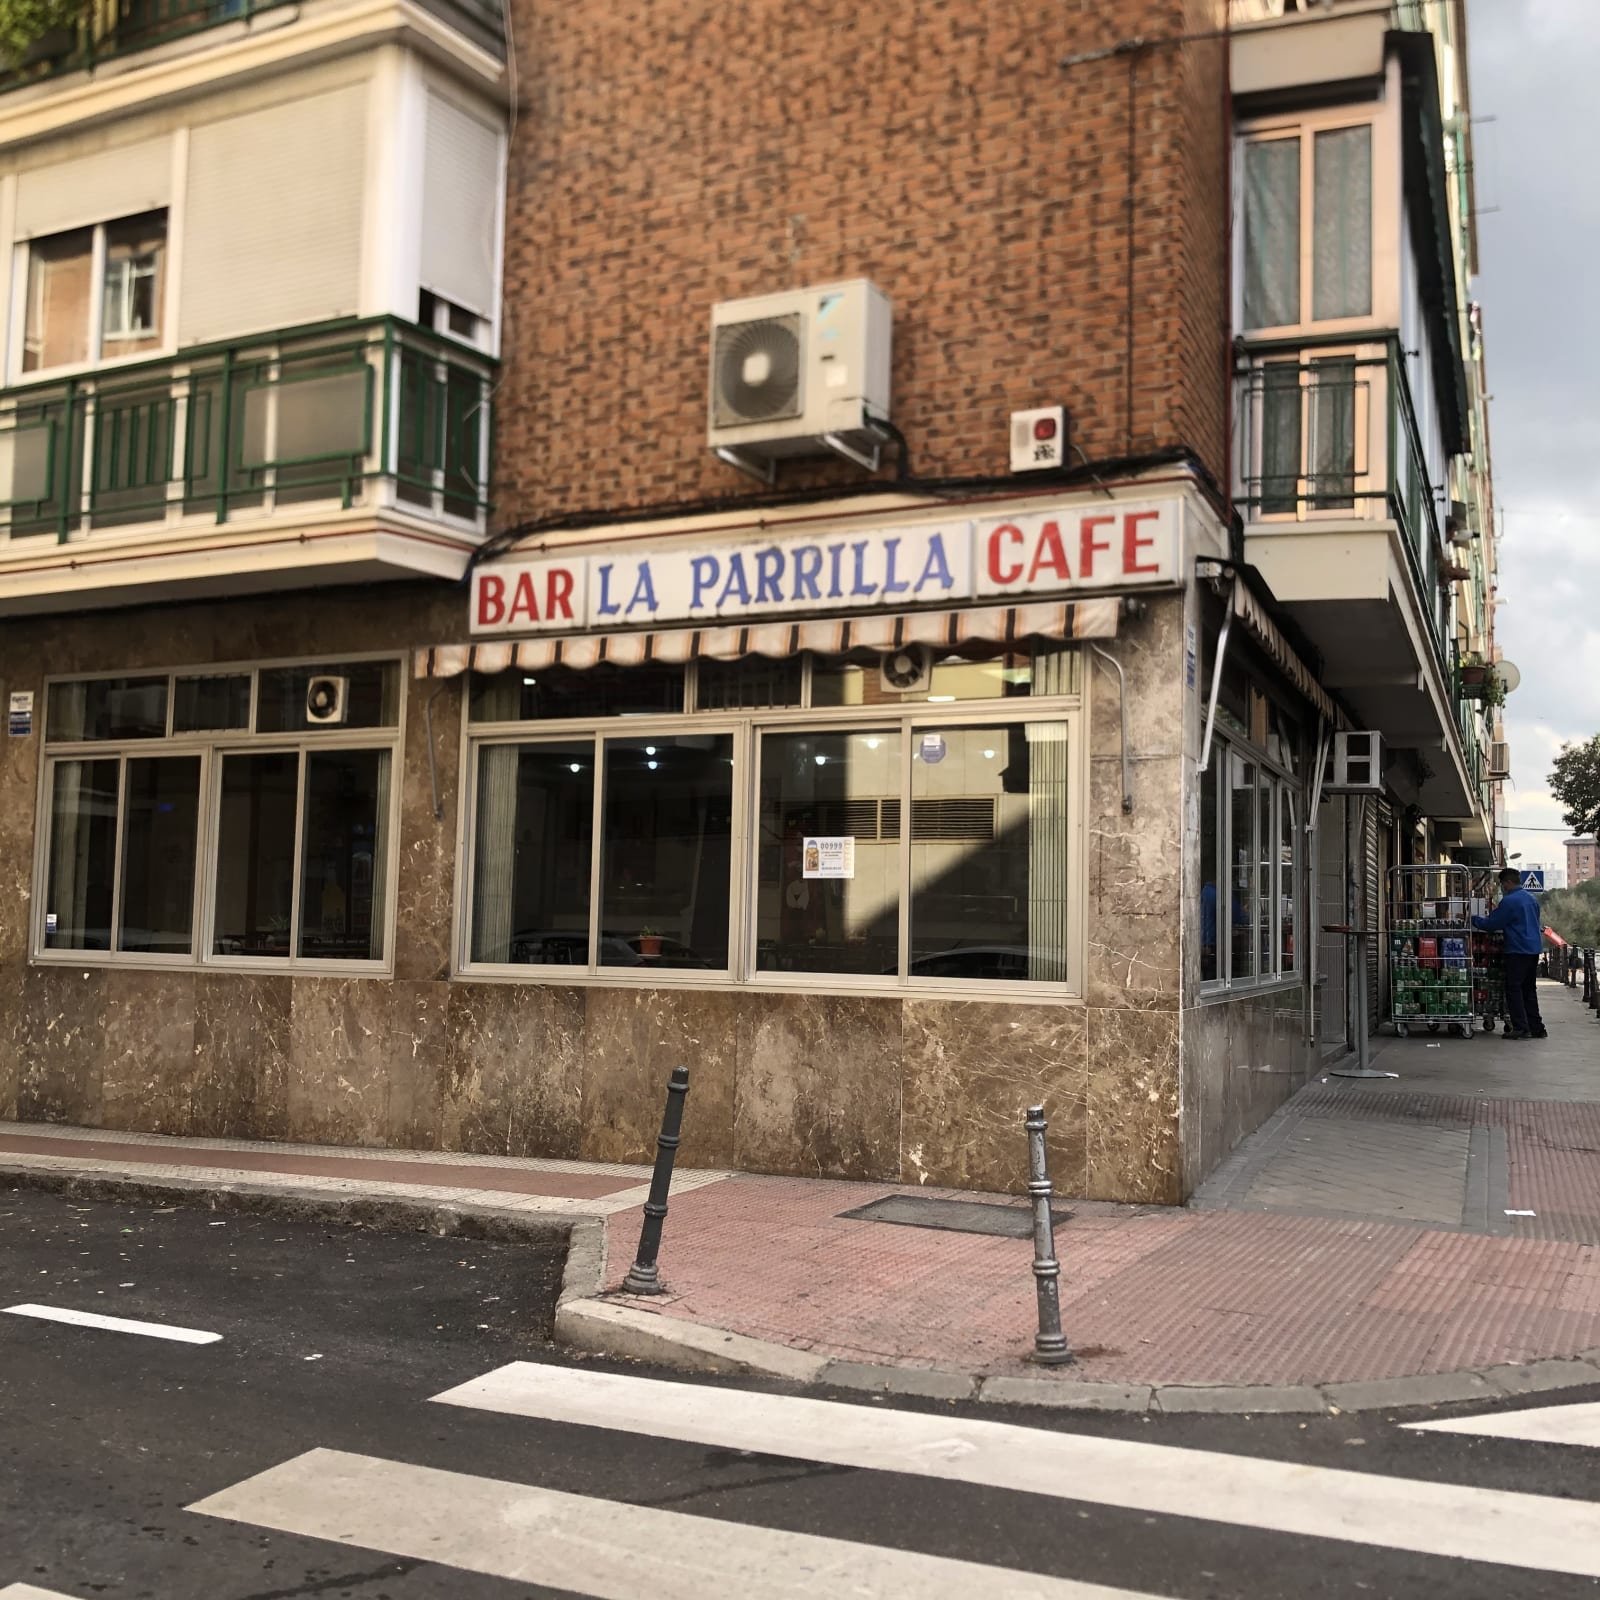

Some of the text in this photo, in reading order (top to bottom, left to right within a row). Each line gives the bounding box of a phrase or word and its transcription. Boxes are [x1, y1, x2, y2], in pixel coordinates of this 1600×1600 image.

[477, 511, 1160, 626] BAR LA PARRILLA CAFE
[820, 842, 843, 850] 00999
